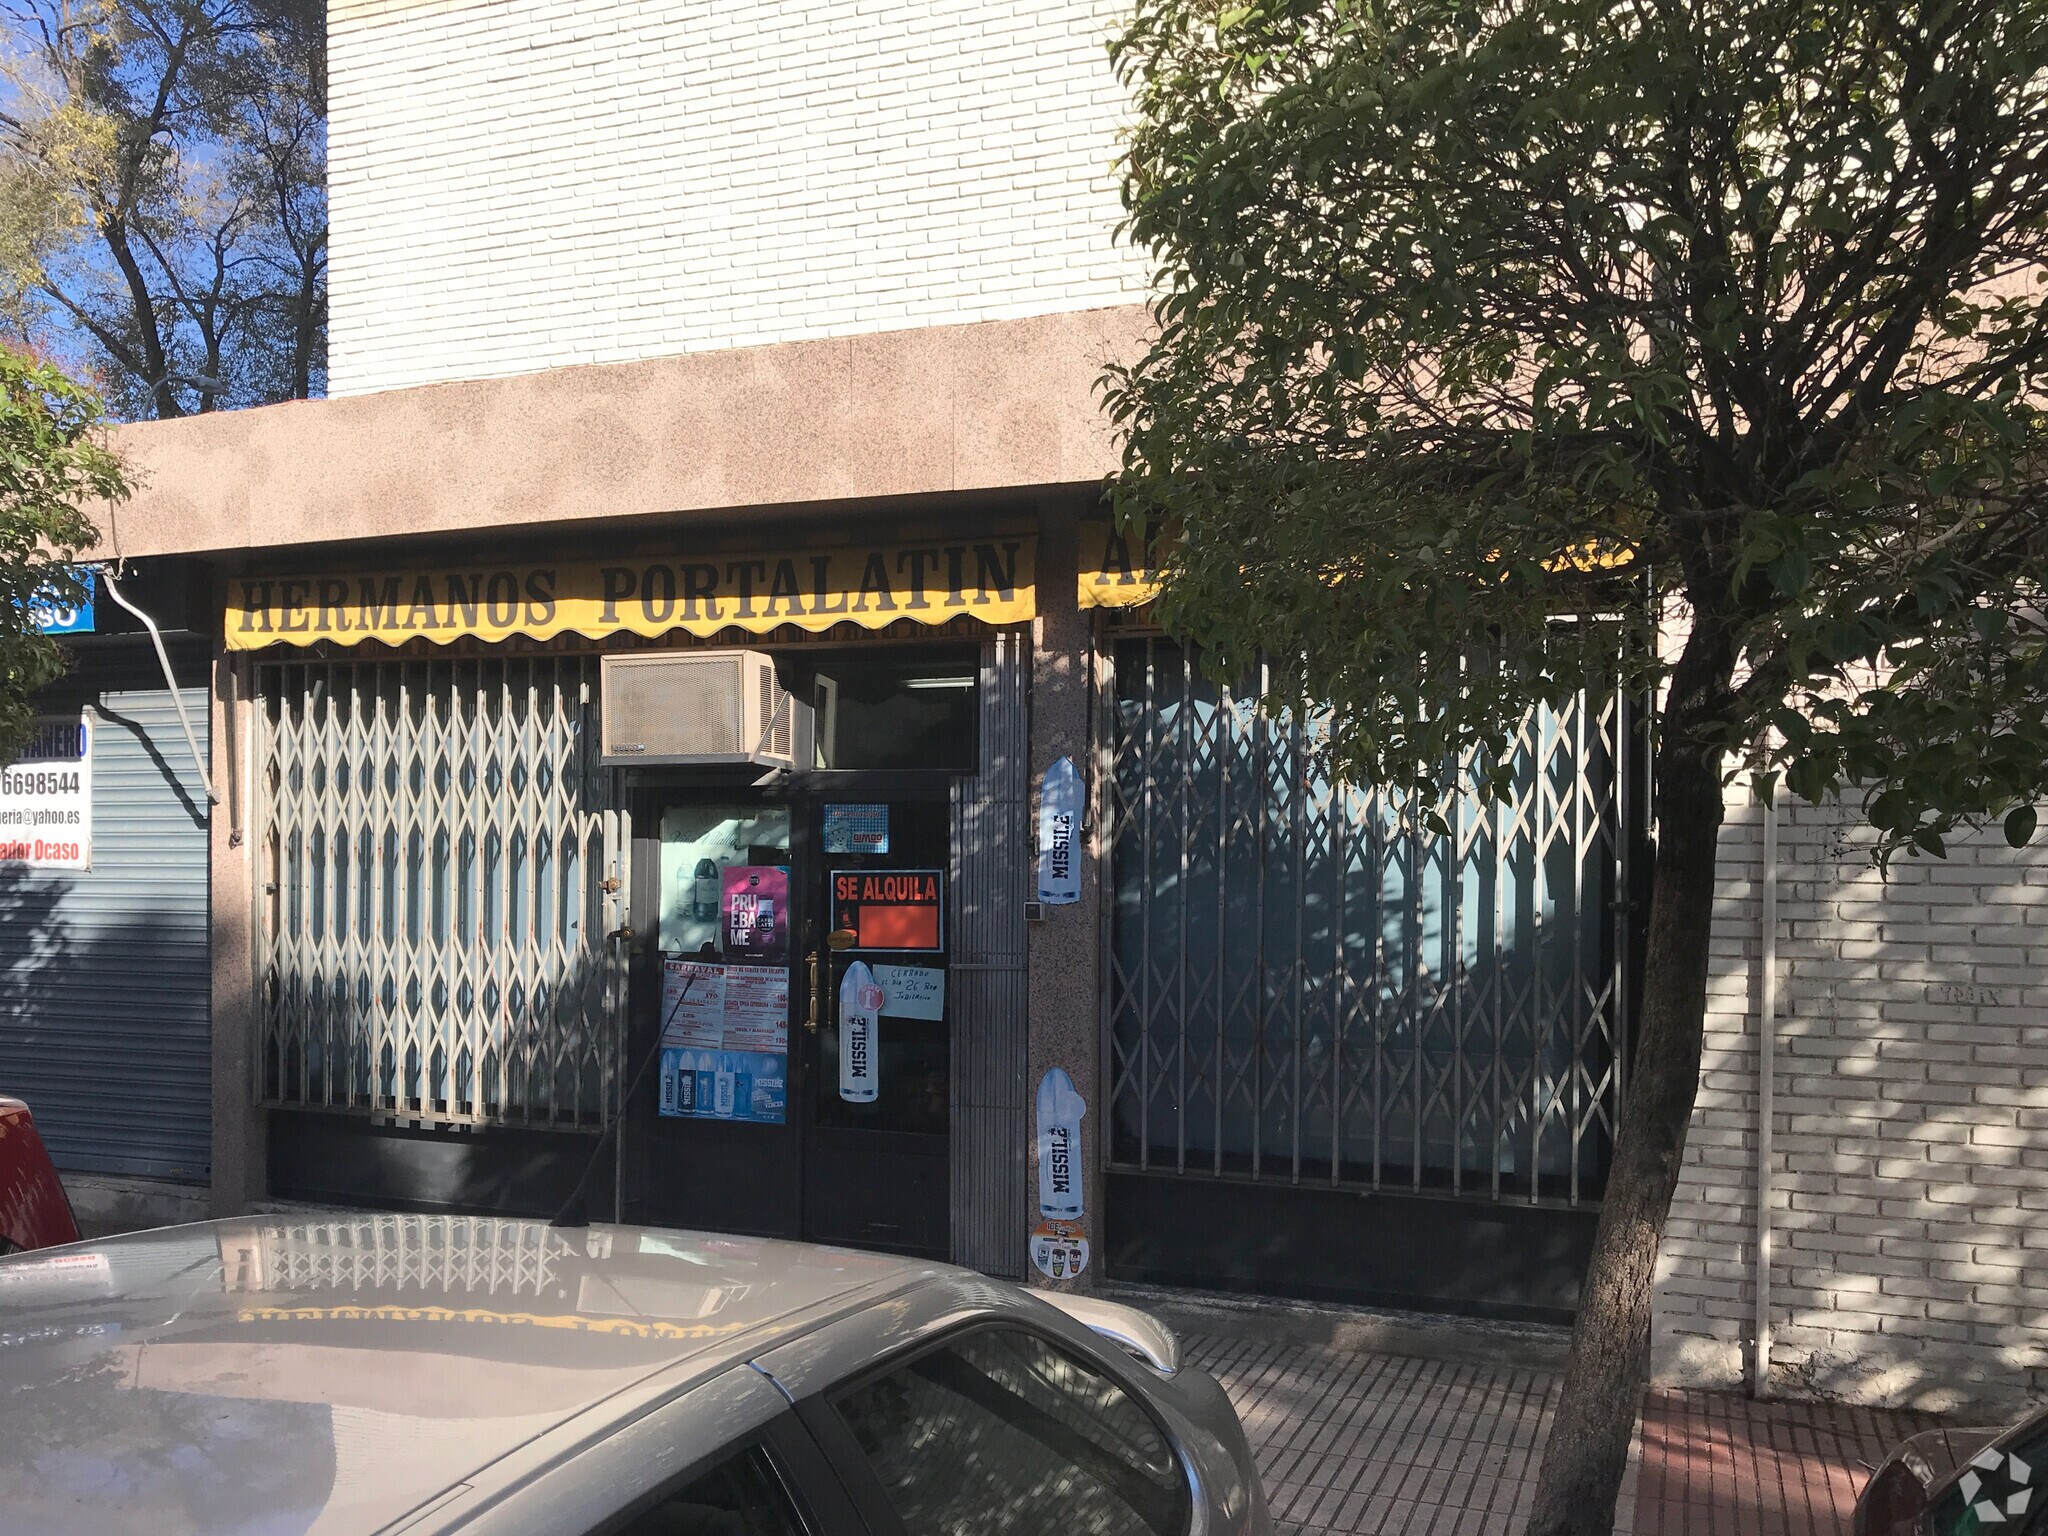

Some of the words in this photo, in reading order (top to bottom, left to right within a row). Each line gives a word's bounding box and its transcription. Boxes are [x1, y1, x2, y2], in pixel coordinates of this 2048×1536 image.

[238, 569, 557, 634] HERMANOS
[599, 542, 1021, 624] PORTALATIN
[0, 772, 80, 795] 6698544
[0, 809, 80, 826] eria@yahoo.es
[853, 833, 883, 843] BIMBO
[1052, 814, 1070, 880] MISSILE
[35, 839, 80, 861] Ocaso
[836, 876, 858, 901] SE
[862, 876, 937, 902] ALQUILA
[731, 894, 758, 911] PRU
[730, 910, 756, 928] EBA
[730, 929, 750, 946] ME
[669, 963, 719, 974] CARNAVAL
[891, 969, 930, 979] CERRADO
[905, 980, 918, 991] 26
[851, 1017, 867, 1078] MISSILE
[665, 1073, 673, 1104] MISSILE
[1052, 1128, 1070, 1194] MISSILE
